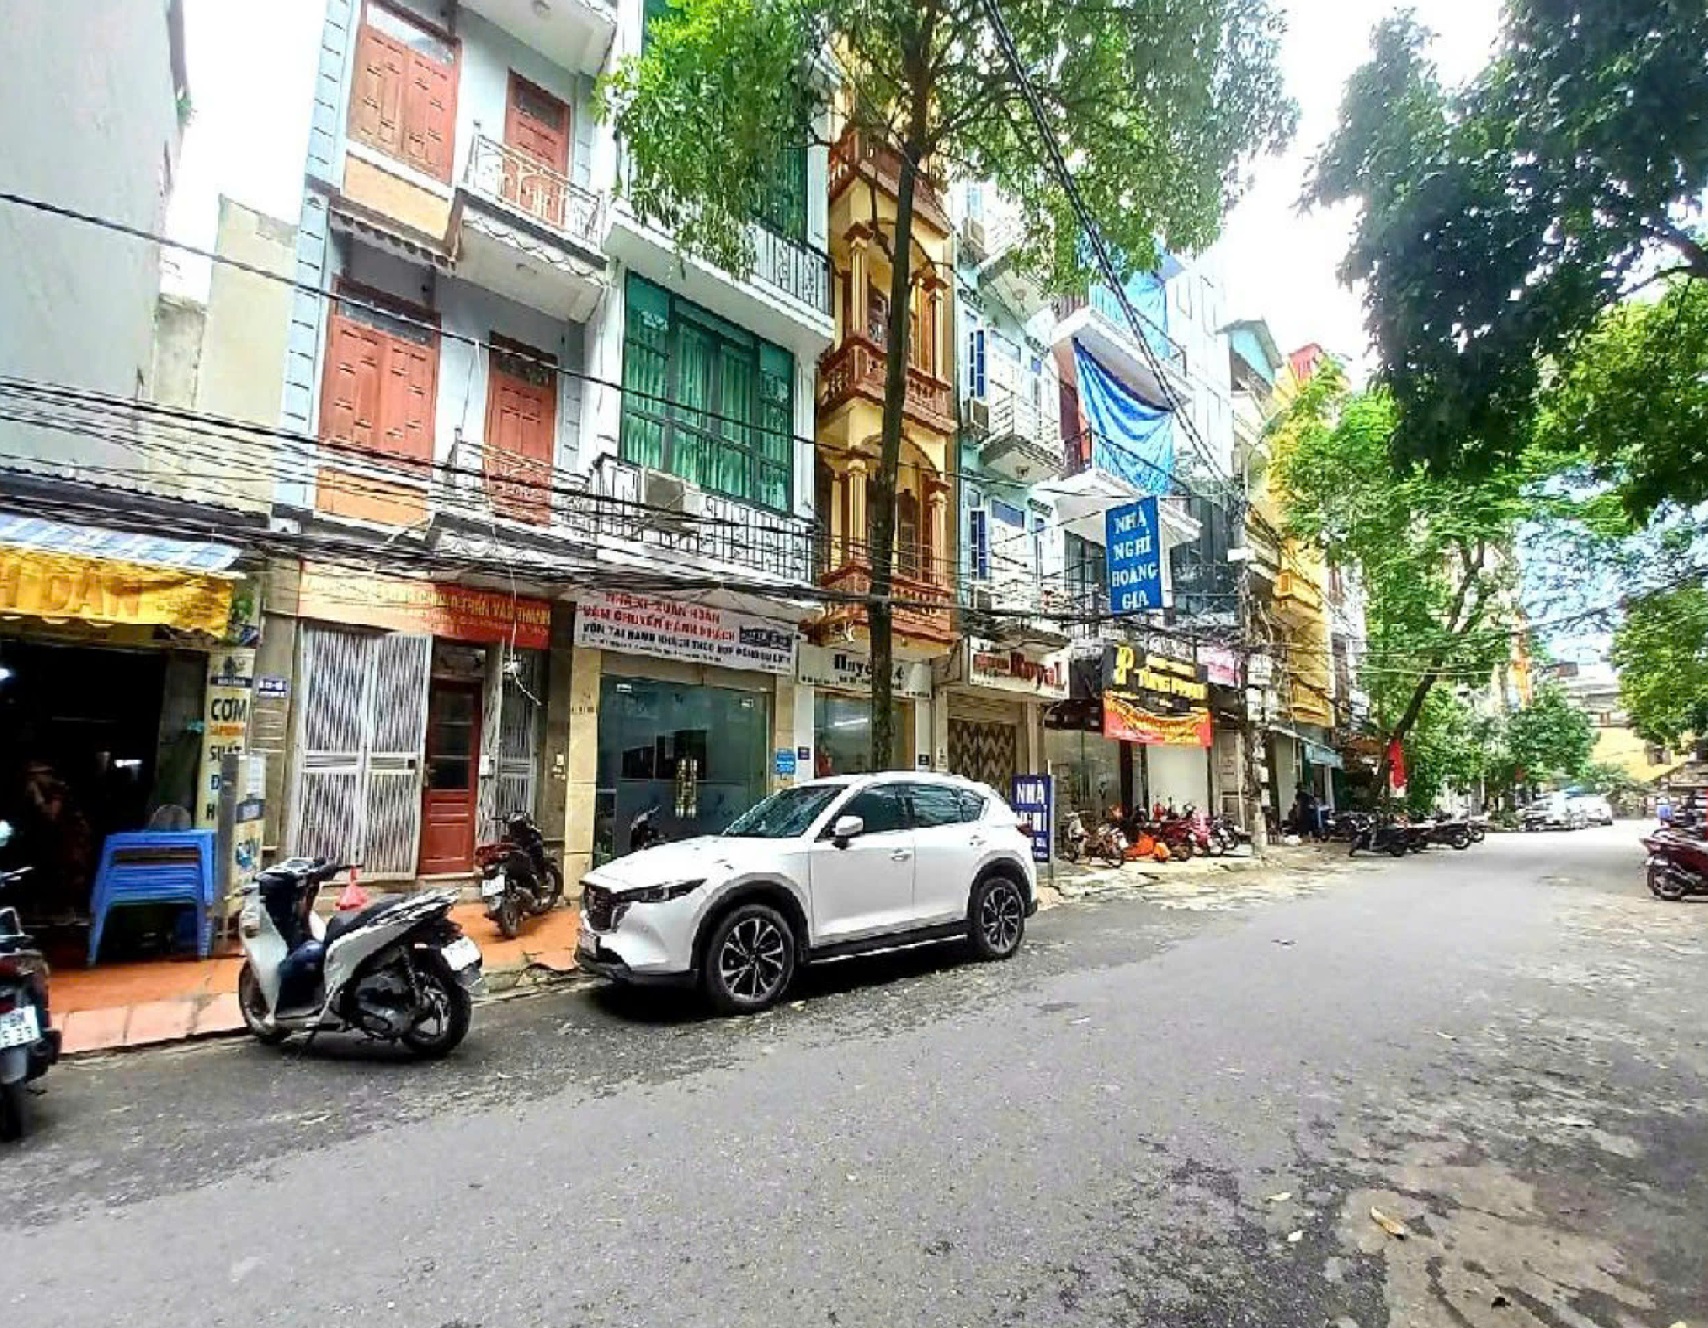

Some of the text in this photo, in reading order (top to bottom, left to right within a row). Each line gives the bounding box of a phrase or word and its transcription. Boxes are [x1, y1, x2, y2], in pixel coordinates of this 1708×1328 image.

[1114, 505, 1147, 534] NHÀ
[1113, 527, 1152, 560] NGHỈ
[1111, 561, 1158, 587] HOÀNG
[1122, 590, 1149, 609] GIA
[1016, 779, 1045, 804] NHÀ
